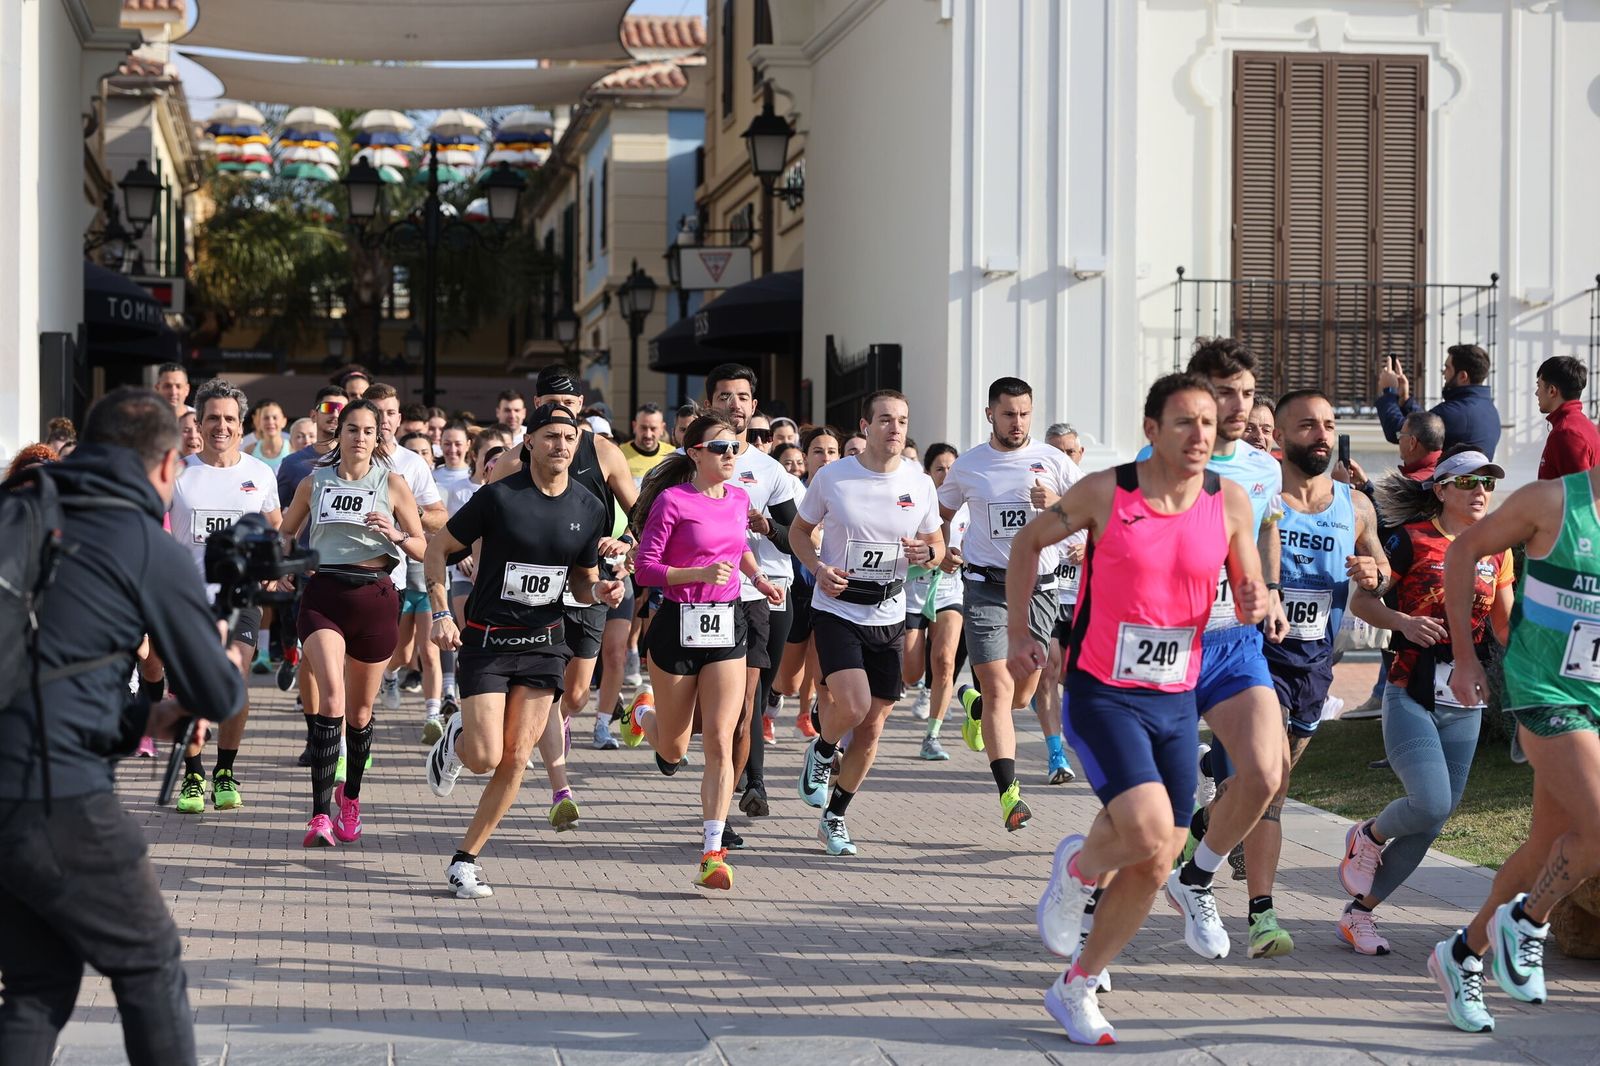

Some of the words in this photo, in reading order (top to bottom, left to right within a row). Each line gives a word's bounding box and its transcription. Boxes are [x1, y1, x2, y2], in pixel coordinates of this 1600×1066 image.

[331, 495, 363, 512] 408
[205, 517, 232, 534] 501
[999, 509, 1027, 528] 123
[1316, 520, 1330, 528] C.A.
[862, 550, 884, 569] 27
[1053, 563, 1077, 580] 480
[520, 574, 551, 594] 108
[1285, 600, 1319, 624] 169
[1556, 592, 1600, 615] TORRE
[699, 613, 721, 634] 84
[489, 634, 547, 646] WONG
[1136, 639, 1178, 667] 240
